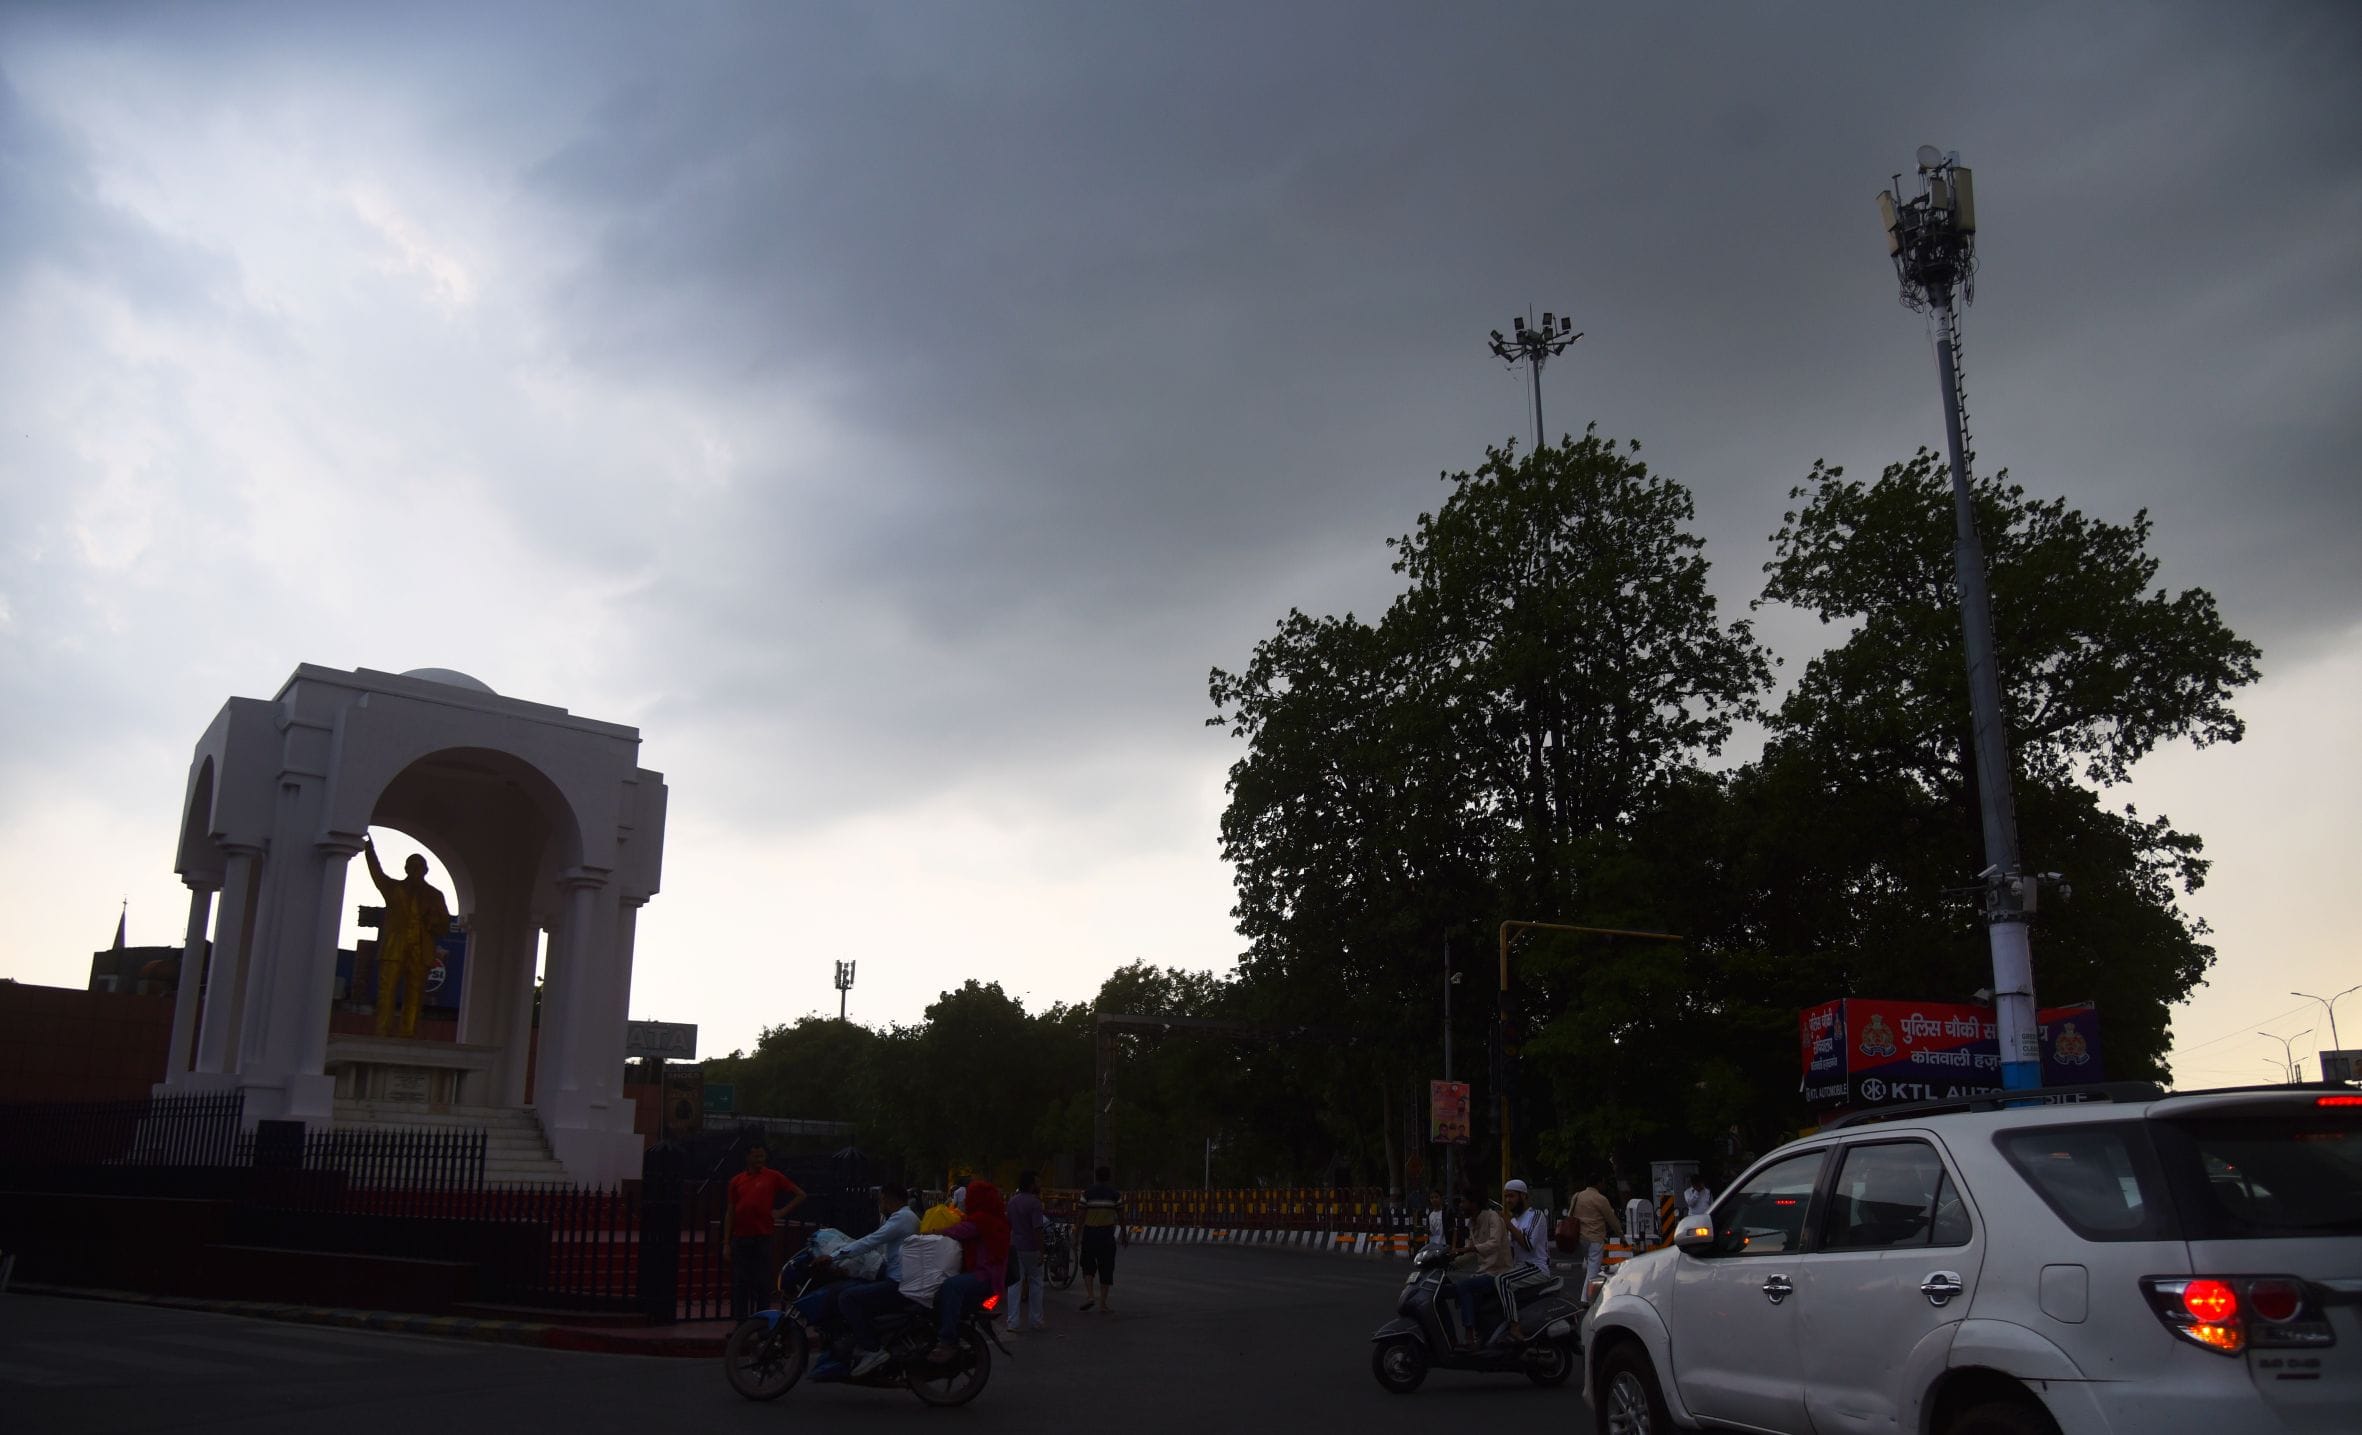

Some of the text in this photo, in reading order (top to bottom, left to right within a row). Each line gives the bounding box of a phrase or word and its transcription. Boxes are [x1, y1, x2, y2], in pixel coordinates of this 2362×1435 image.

[627, 1026, 689, 1051] ATA
[1900, 1012, 1942, 1044] पुलिस
[1944, 1014, 1980, 1039] चौकी
[1910, 1046, 1970, 1066] कोतवाली
[1891, 1082, 1938, 1100] KTL
